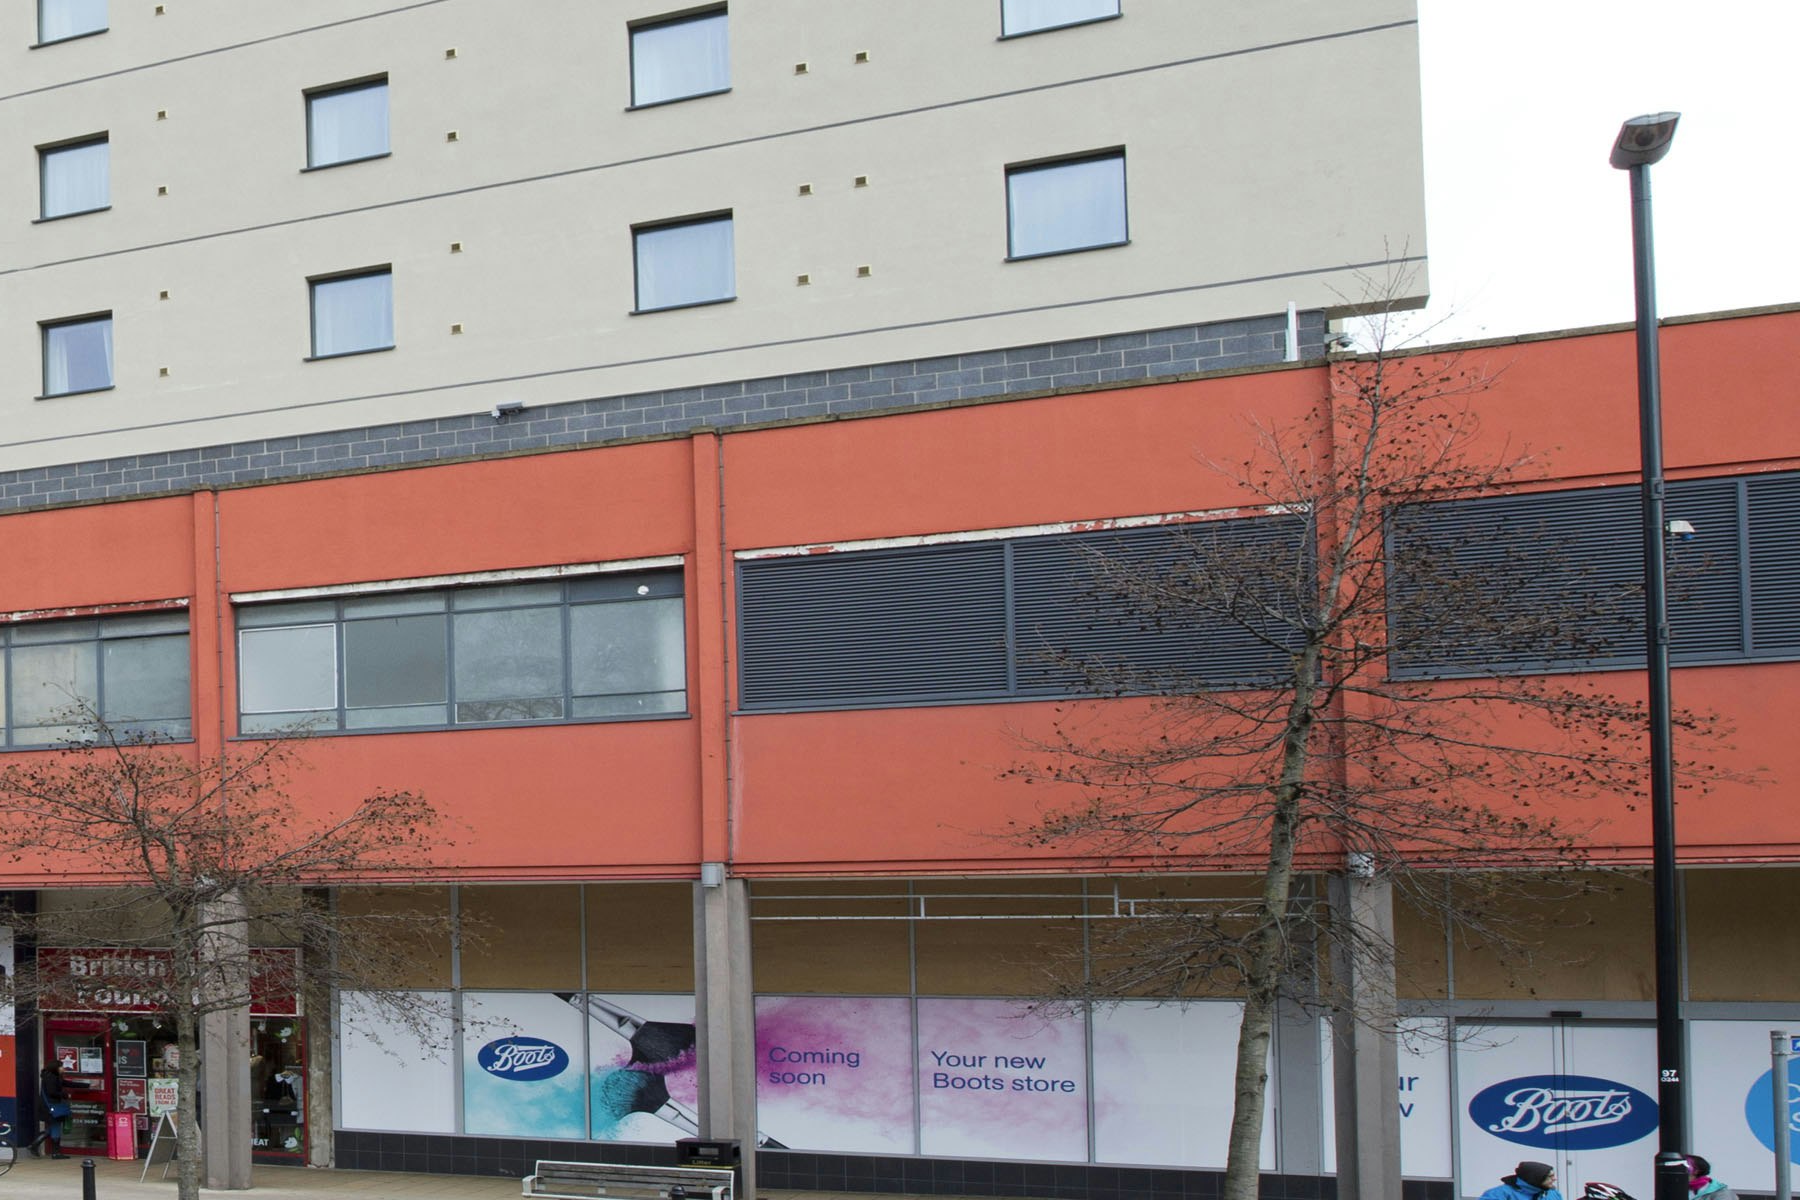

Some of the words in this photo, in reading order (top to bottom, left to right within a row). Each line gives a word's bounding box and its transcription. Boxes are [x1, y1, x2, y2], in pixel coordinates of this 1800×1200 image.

[70, 955, 166, 977] British
[487, 1044, 556, 1073] Boots
[768, 1046, 861, 1068] Coming
[931, 1050, 987, 1069] Your
[994, 1055, 1047, 1069] new
[768, 1071, 826, 1085] soon
[933, 1072, 1004, 1090] Boots
[1011, 1075, 1076, 1092] store
[1662, 1069, 1677, 1077] 97
[1488, 1087, 1633, 1135] Boots
